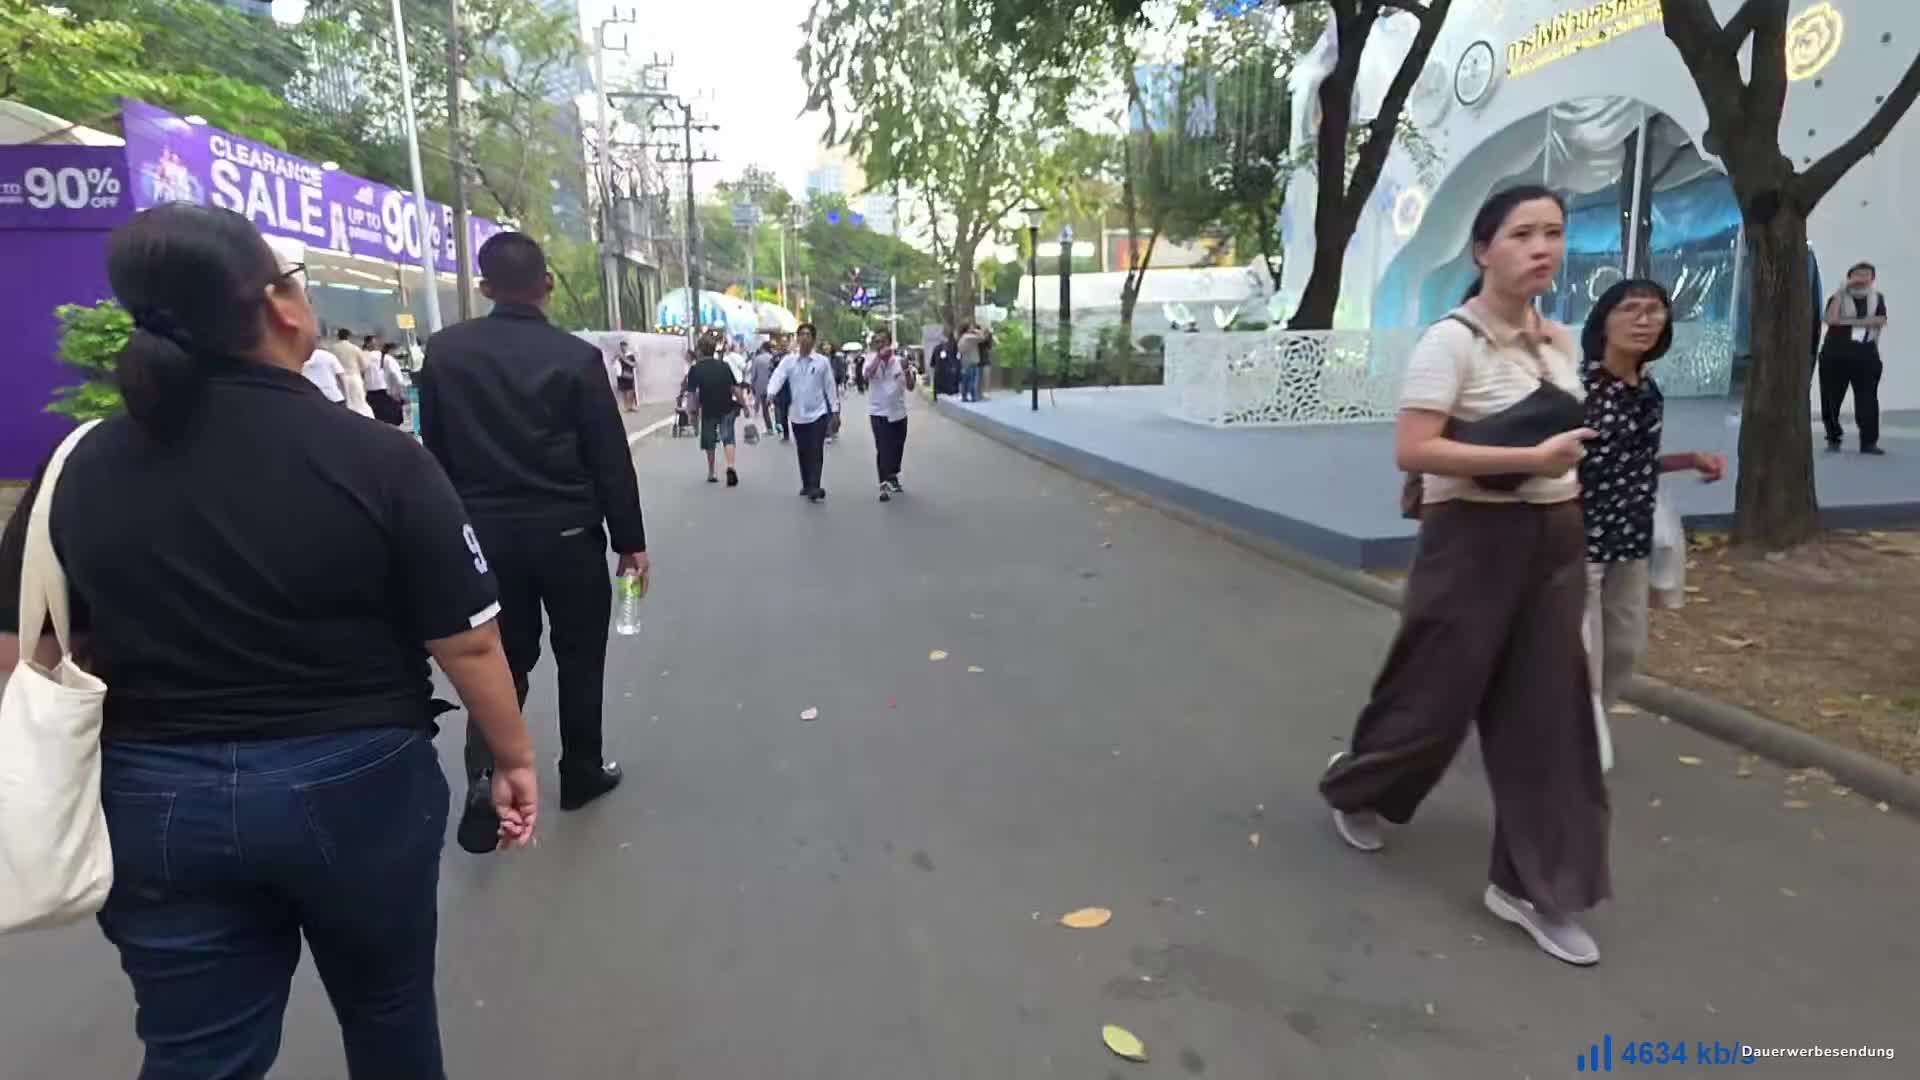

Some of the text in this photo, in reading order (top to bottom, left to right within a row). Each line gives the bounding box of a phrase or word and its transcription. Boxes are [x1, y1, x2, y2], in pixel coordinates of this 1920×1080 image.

[209, 134, 322, 188] CLEARANCE
[24, 166, 121, 209] 90%
[90, 196, 119, 208] OFF
[211, 159, 326, 238] SALE
[347, 206, 365, 225] UP
[365, 212, 382, 230] TO
